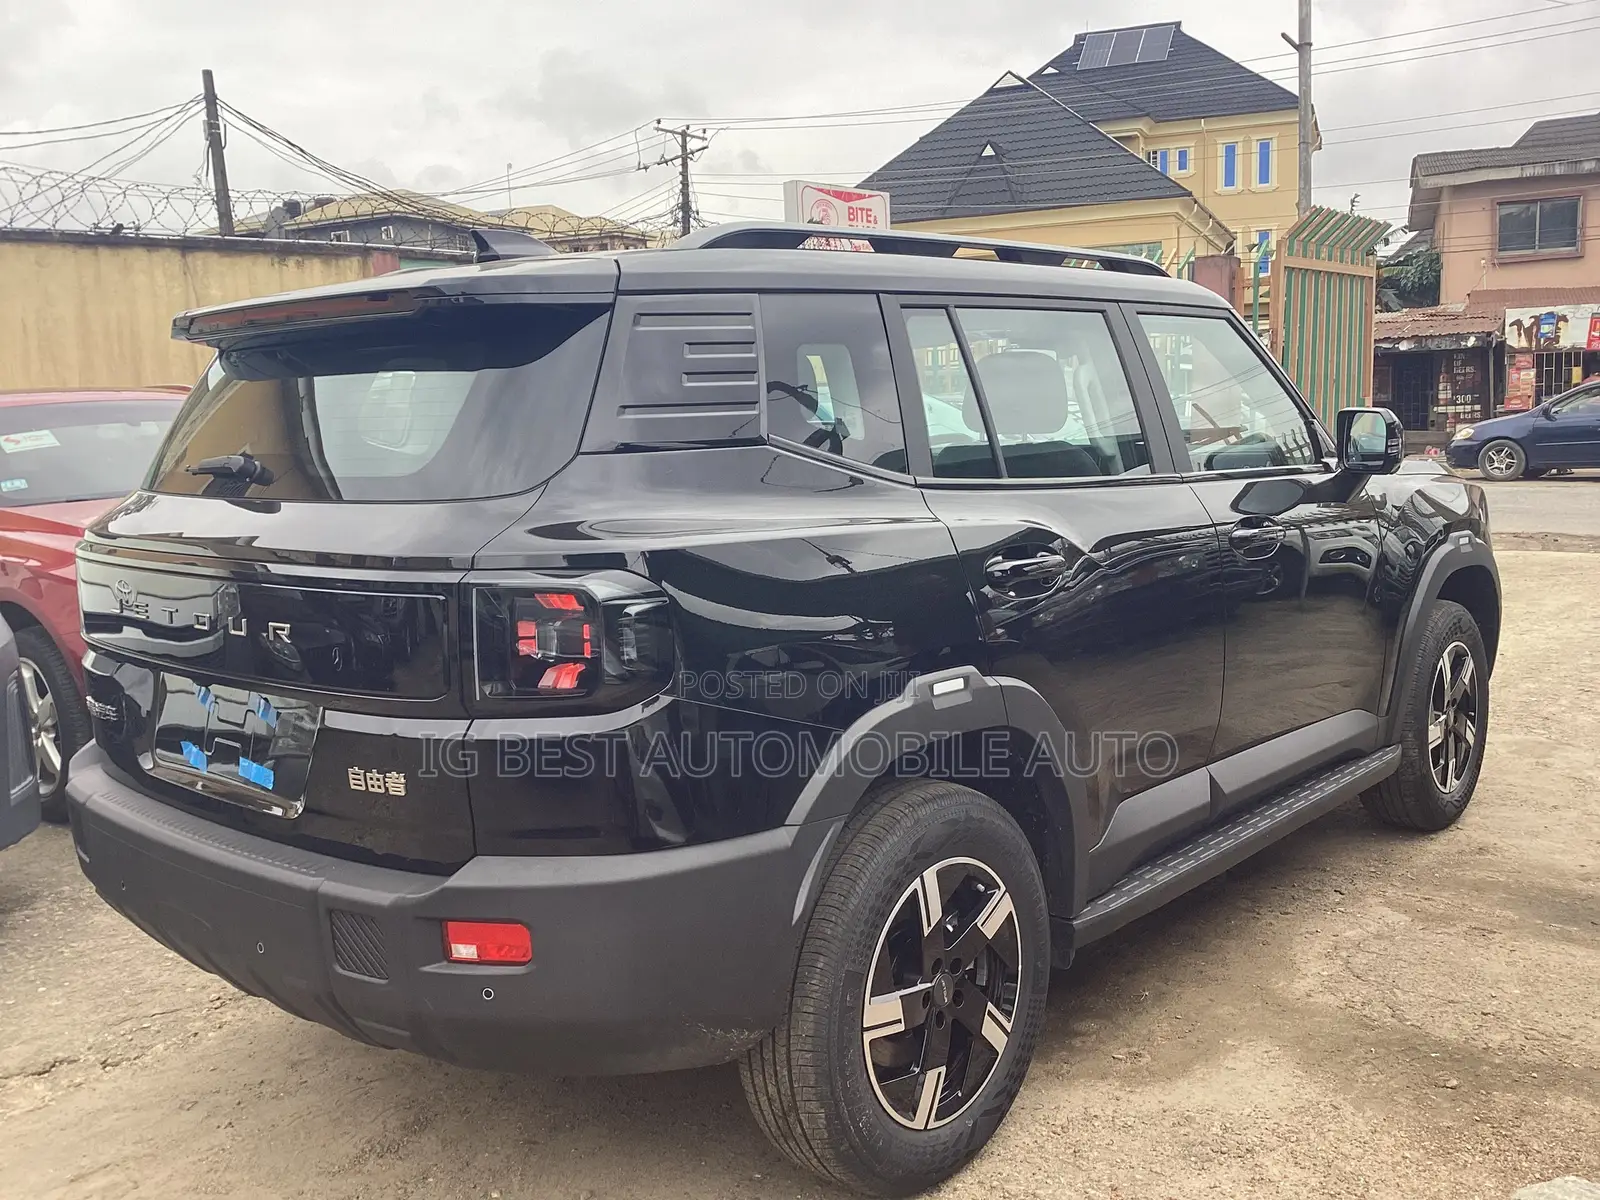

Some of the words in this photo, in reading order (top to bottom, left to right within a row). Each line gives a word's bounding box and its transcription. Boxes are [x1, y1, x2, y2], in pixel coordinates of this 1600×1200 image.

[848, 205, 872, 224] BITE
[110, 599, 292, 644] JETOUR
[347, 766, 407, 796] 自由者
